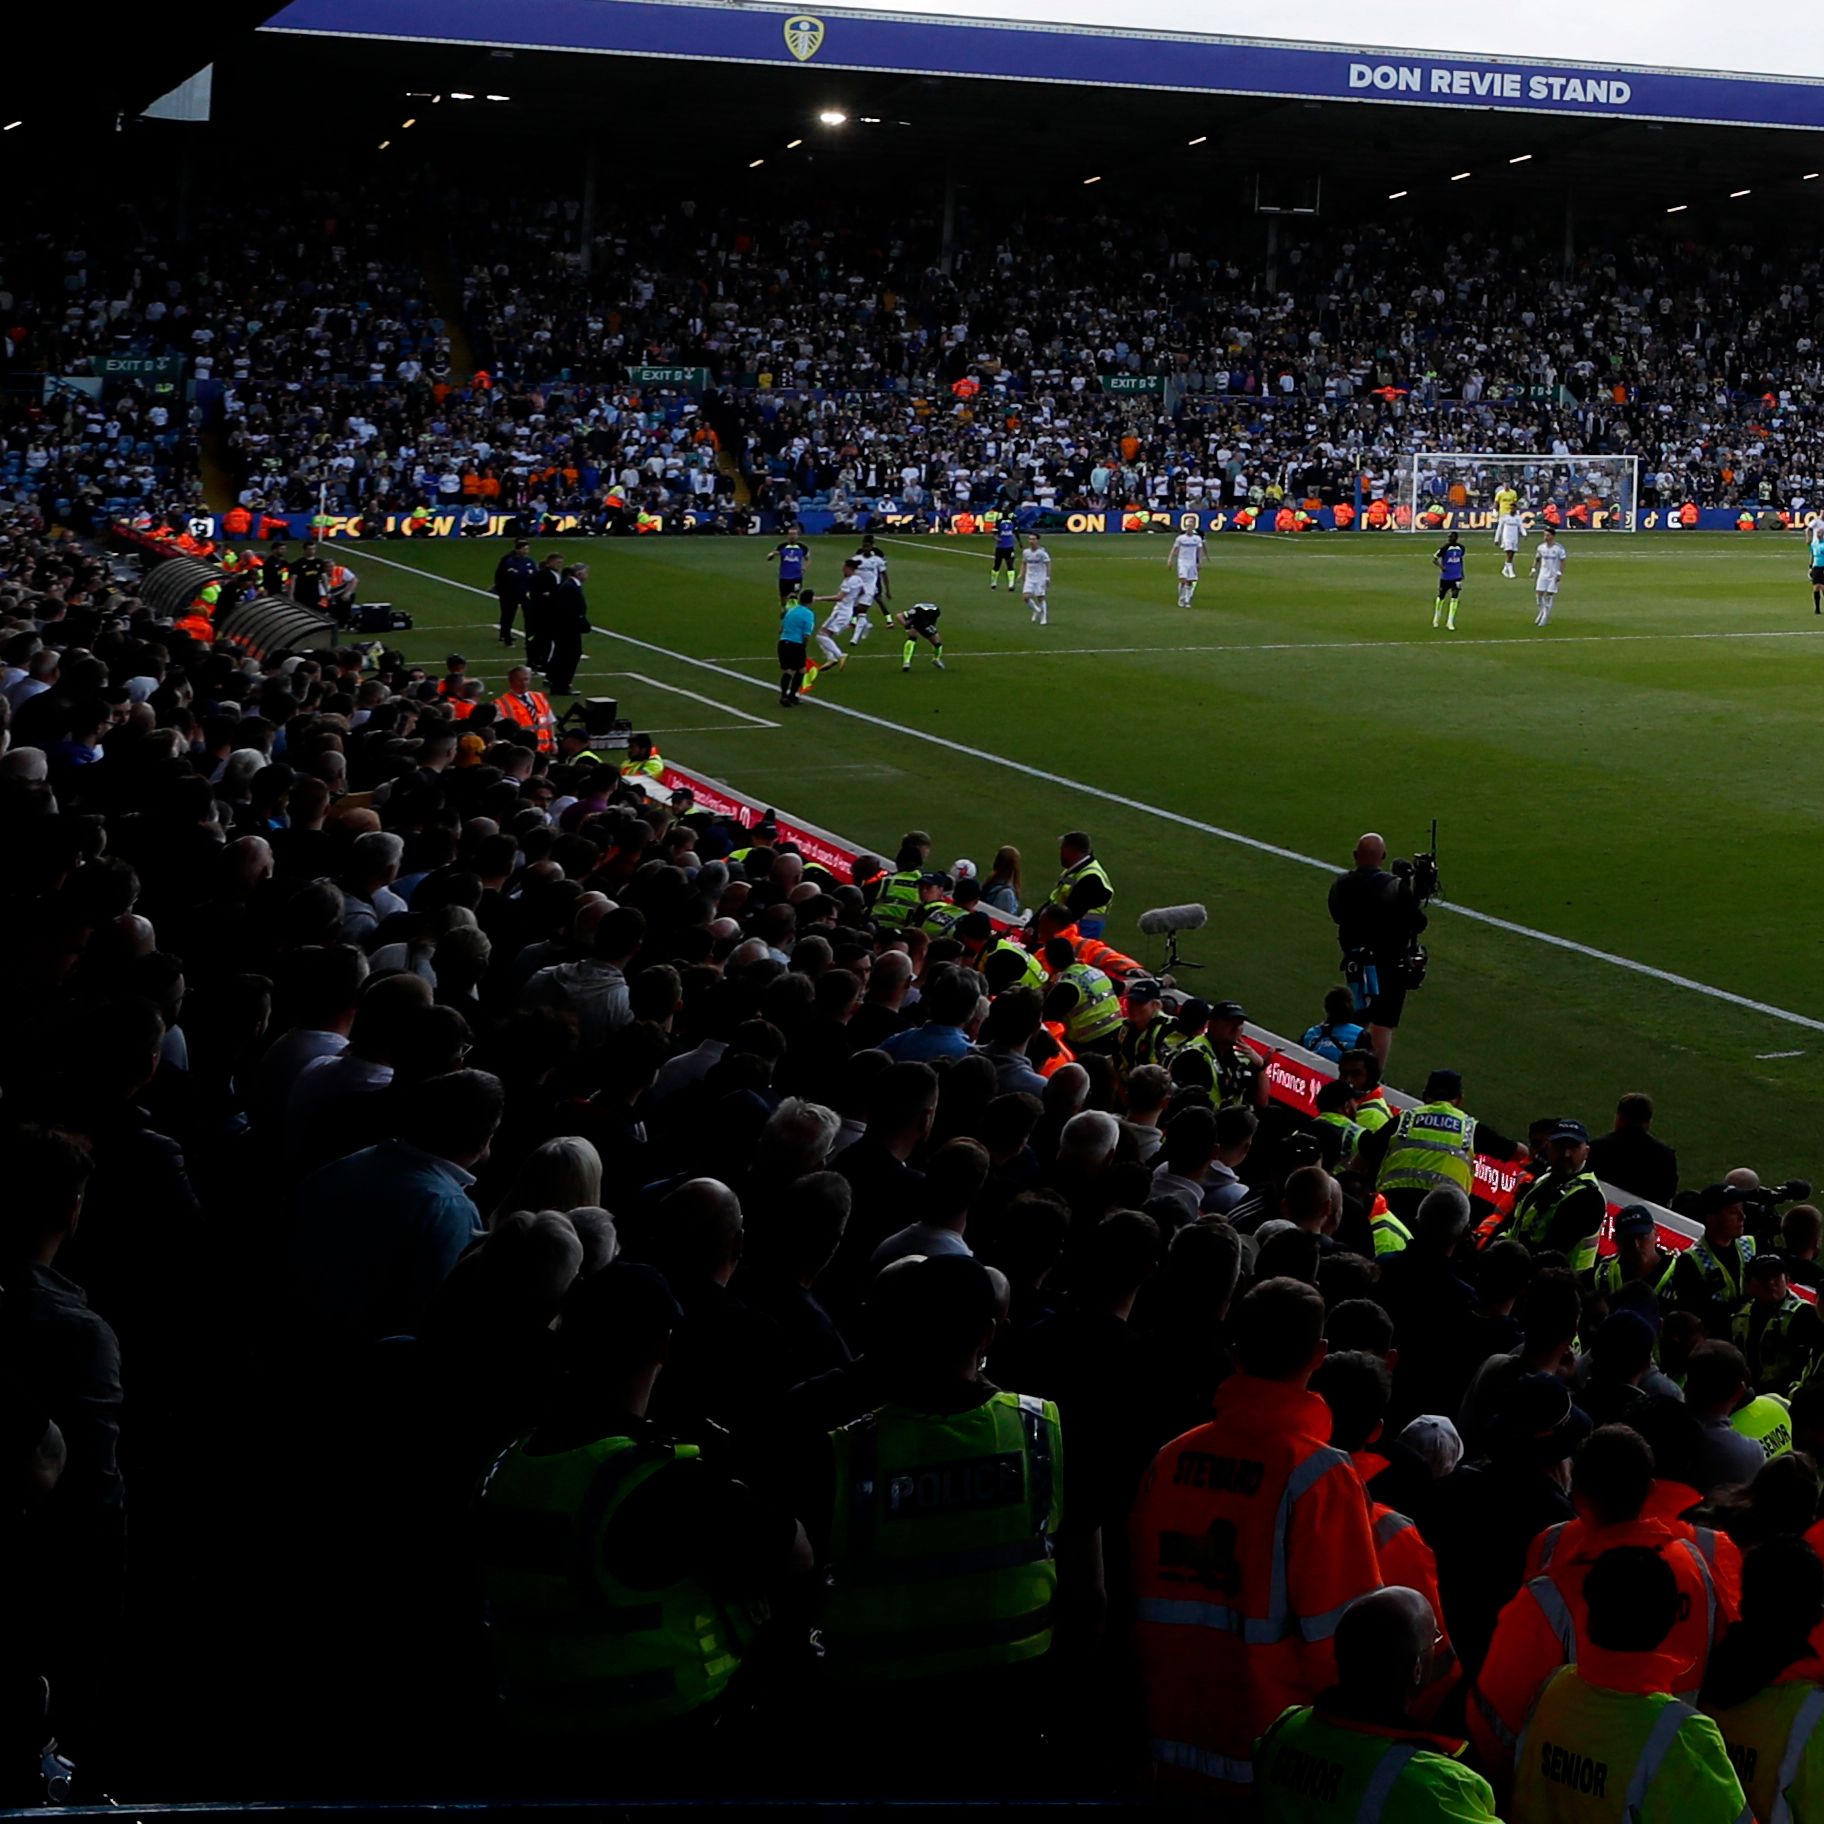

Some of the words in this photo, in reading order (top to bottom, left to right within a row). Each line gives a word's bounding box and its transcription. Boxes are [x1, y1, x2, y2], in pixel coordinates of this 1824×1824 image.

[1349, 64, 1420, 92] DON
[1430, 68, 1521, 97] REVIE
[1529, 75, 1631, 104] STAND
[106, 360, 139, 371] EXIT
[642, 370, 673, 381] EXIT
[1111, 378, 1137, 389] EXIT
[1066, 513, 1105, 533] ON
[1273, 1063, 1305, 1095] Finance
[1415, 1114, 1460, 1132] POLICE
[1542, 1741, 1607, 1798] SENIOR
